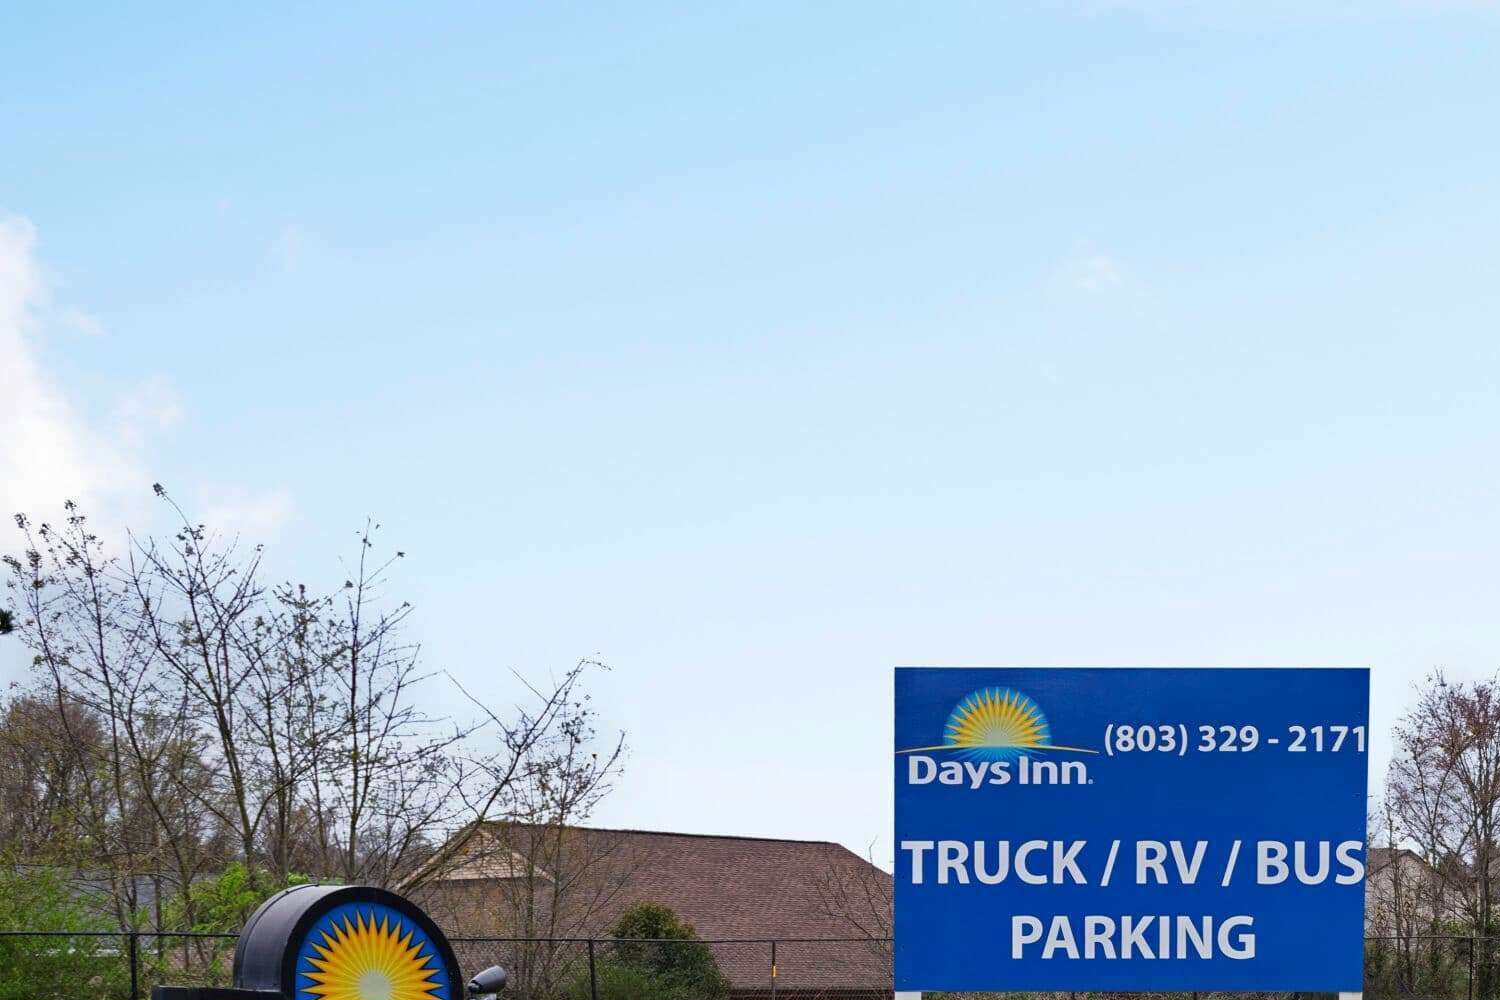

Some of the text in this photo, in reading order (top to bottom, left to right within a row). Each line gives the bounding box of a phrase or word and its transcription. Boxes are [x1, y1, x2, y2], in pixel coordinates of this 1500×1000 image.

[1104, 724, 1188, 756] (803)
[1198, 725, 1259, 752] 329
[1287, 725, 1366, 752] 2171
[908, 755, 1011, 790] Days
[901, 839, 1366, 887] TRUCK / RV / BUS
[1012, 915, 1256, 960] PARKING
